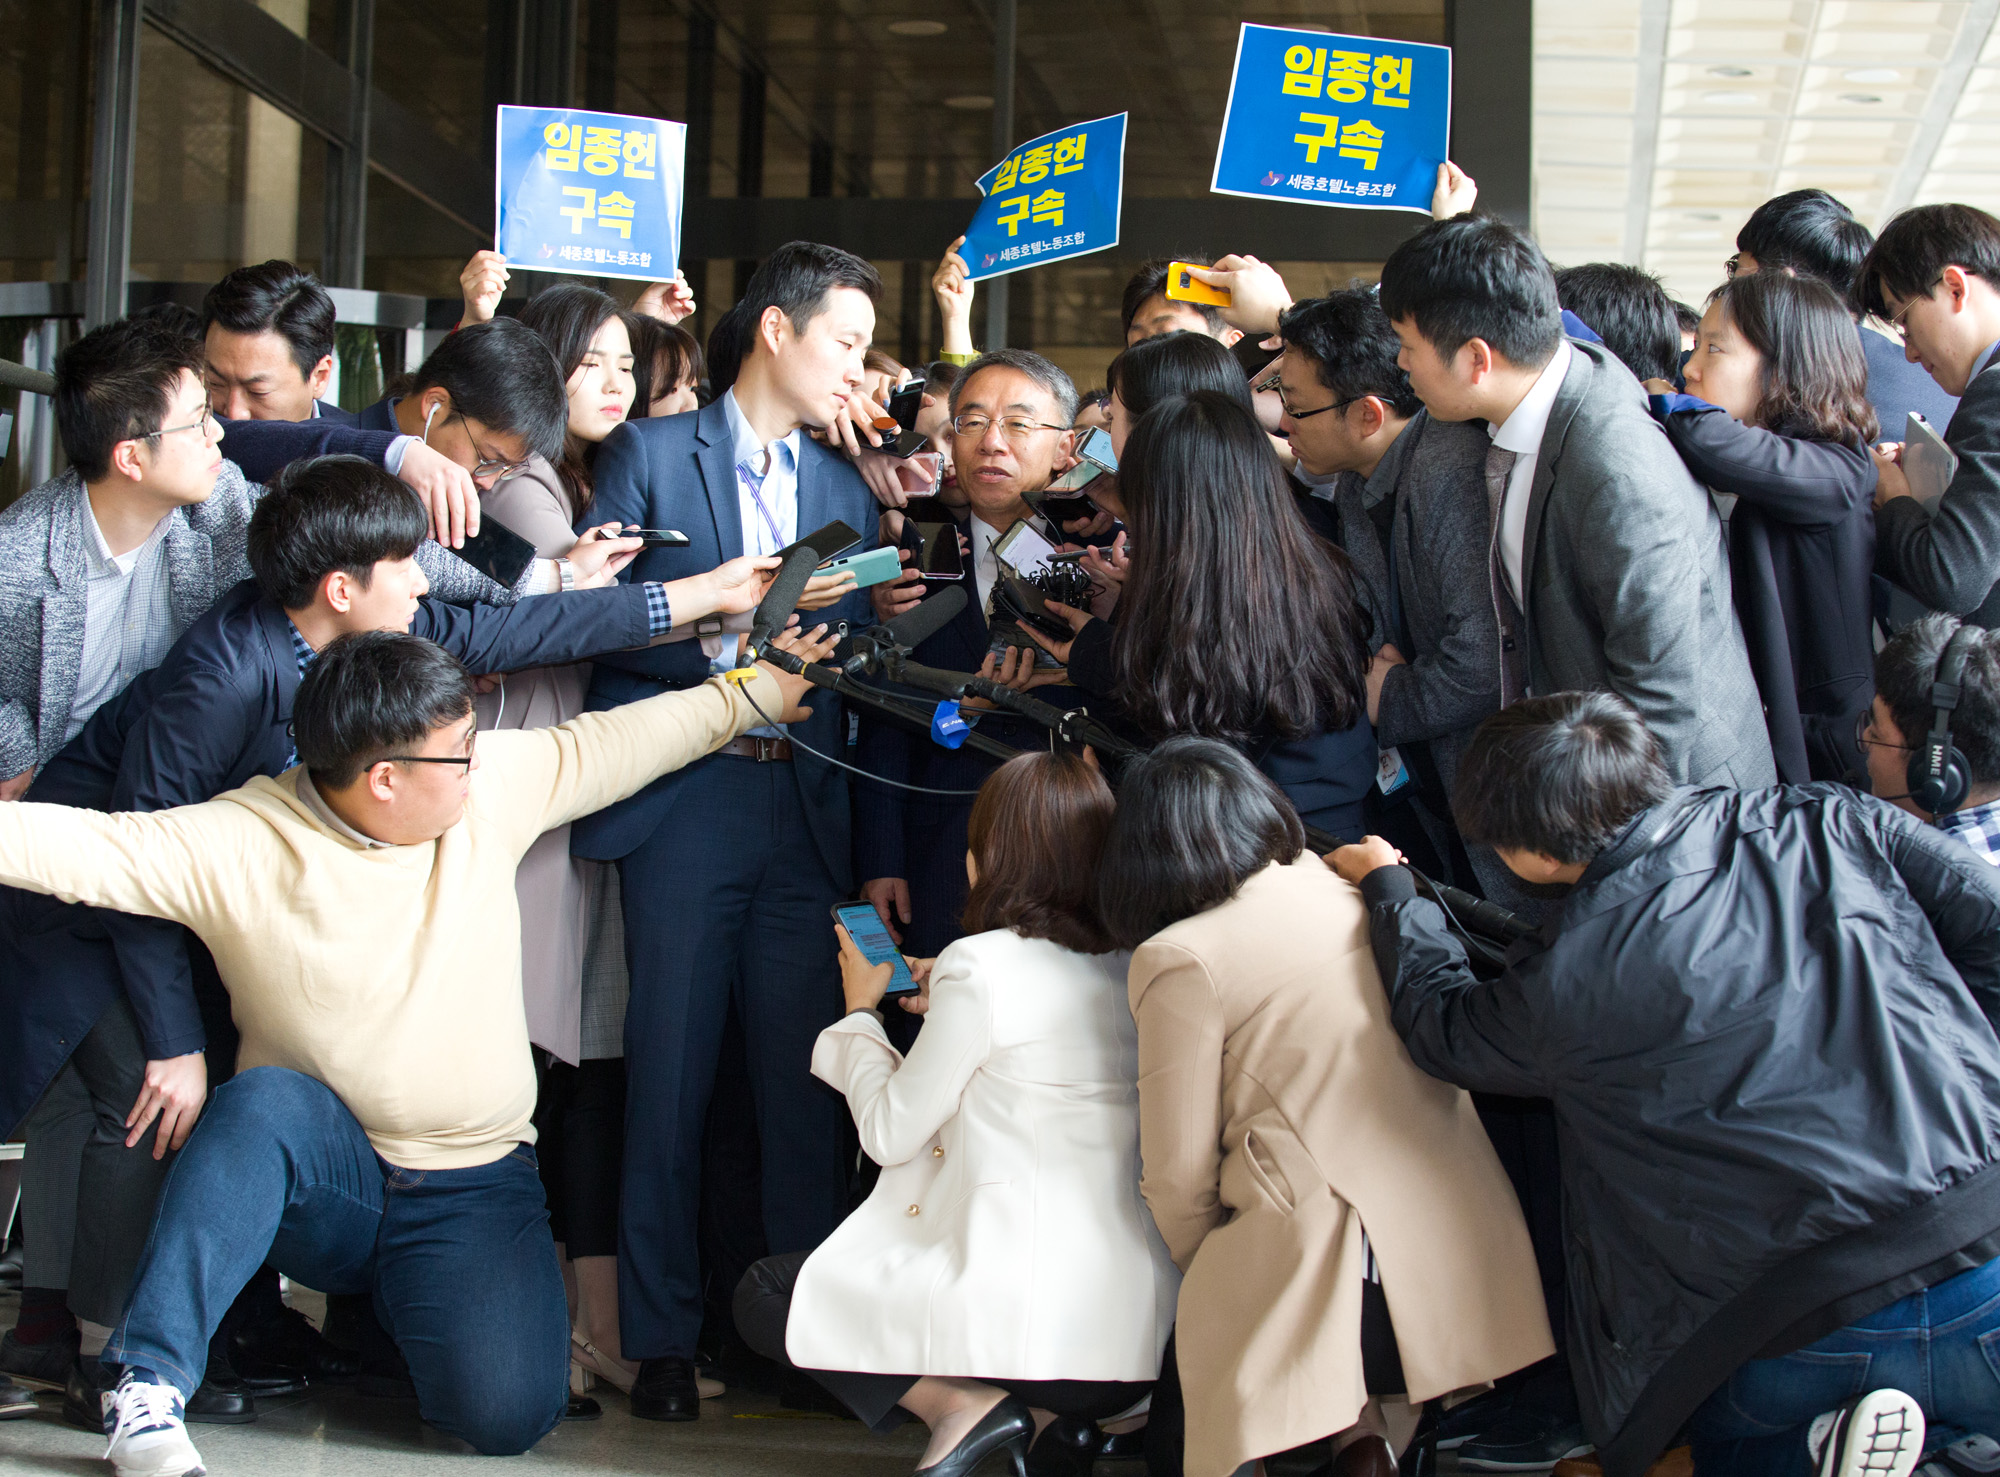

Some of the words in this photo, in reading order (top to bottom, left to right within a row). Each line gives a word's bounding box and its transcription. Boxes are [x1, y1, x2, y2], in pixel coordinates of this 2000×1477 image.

[1282, 45, 1412, 108] 임종헌
[543, 122, 656, 180] 임종헌
[990, 133, 1087, 196] 임종헌
[1294, 112, 1385, 170] 구속
[1286, 174, 1396, 197] 세종호텔노동조합
[560, 186, 635, 239] 구속
[997, 188, 1065, 237] 구속
[559, 245, 652, 268] 세종호텔노동조합
[1000, 231, 1085, 262] 세종호텔노동조합
[1930, 744, 1944, 776] HME
